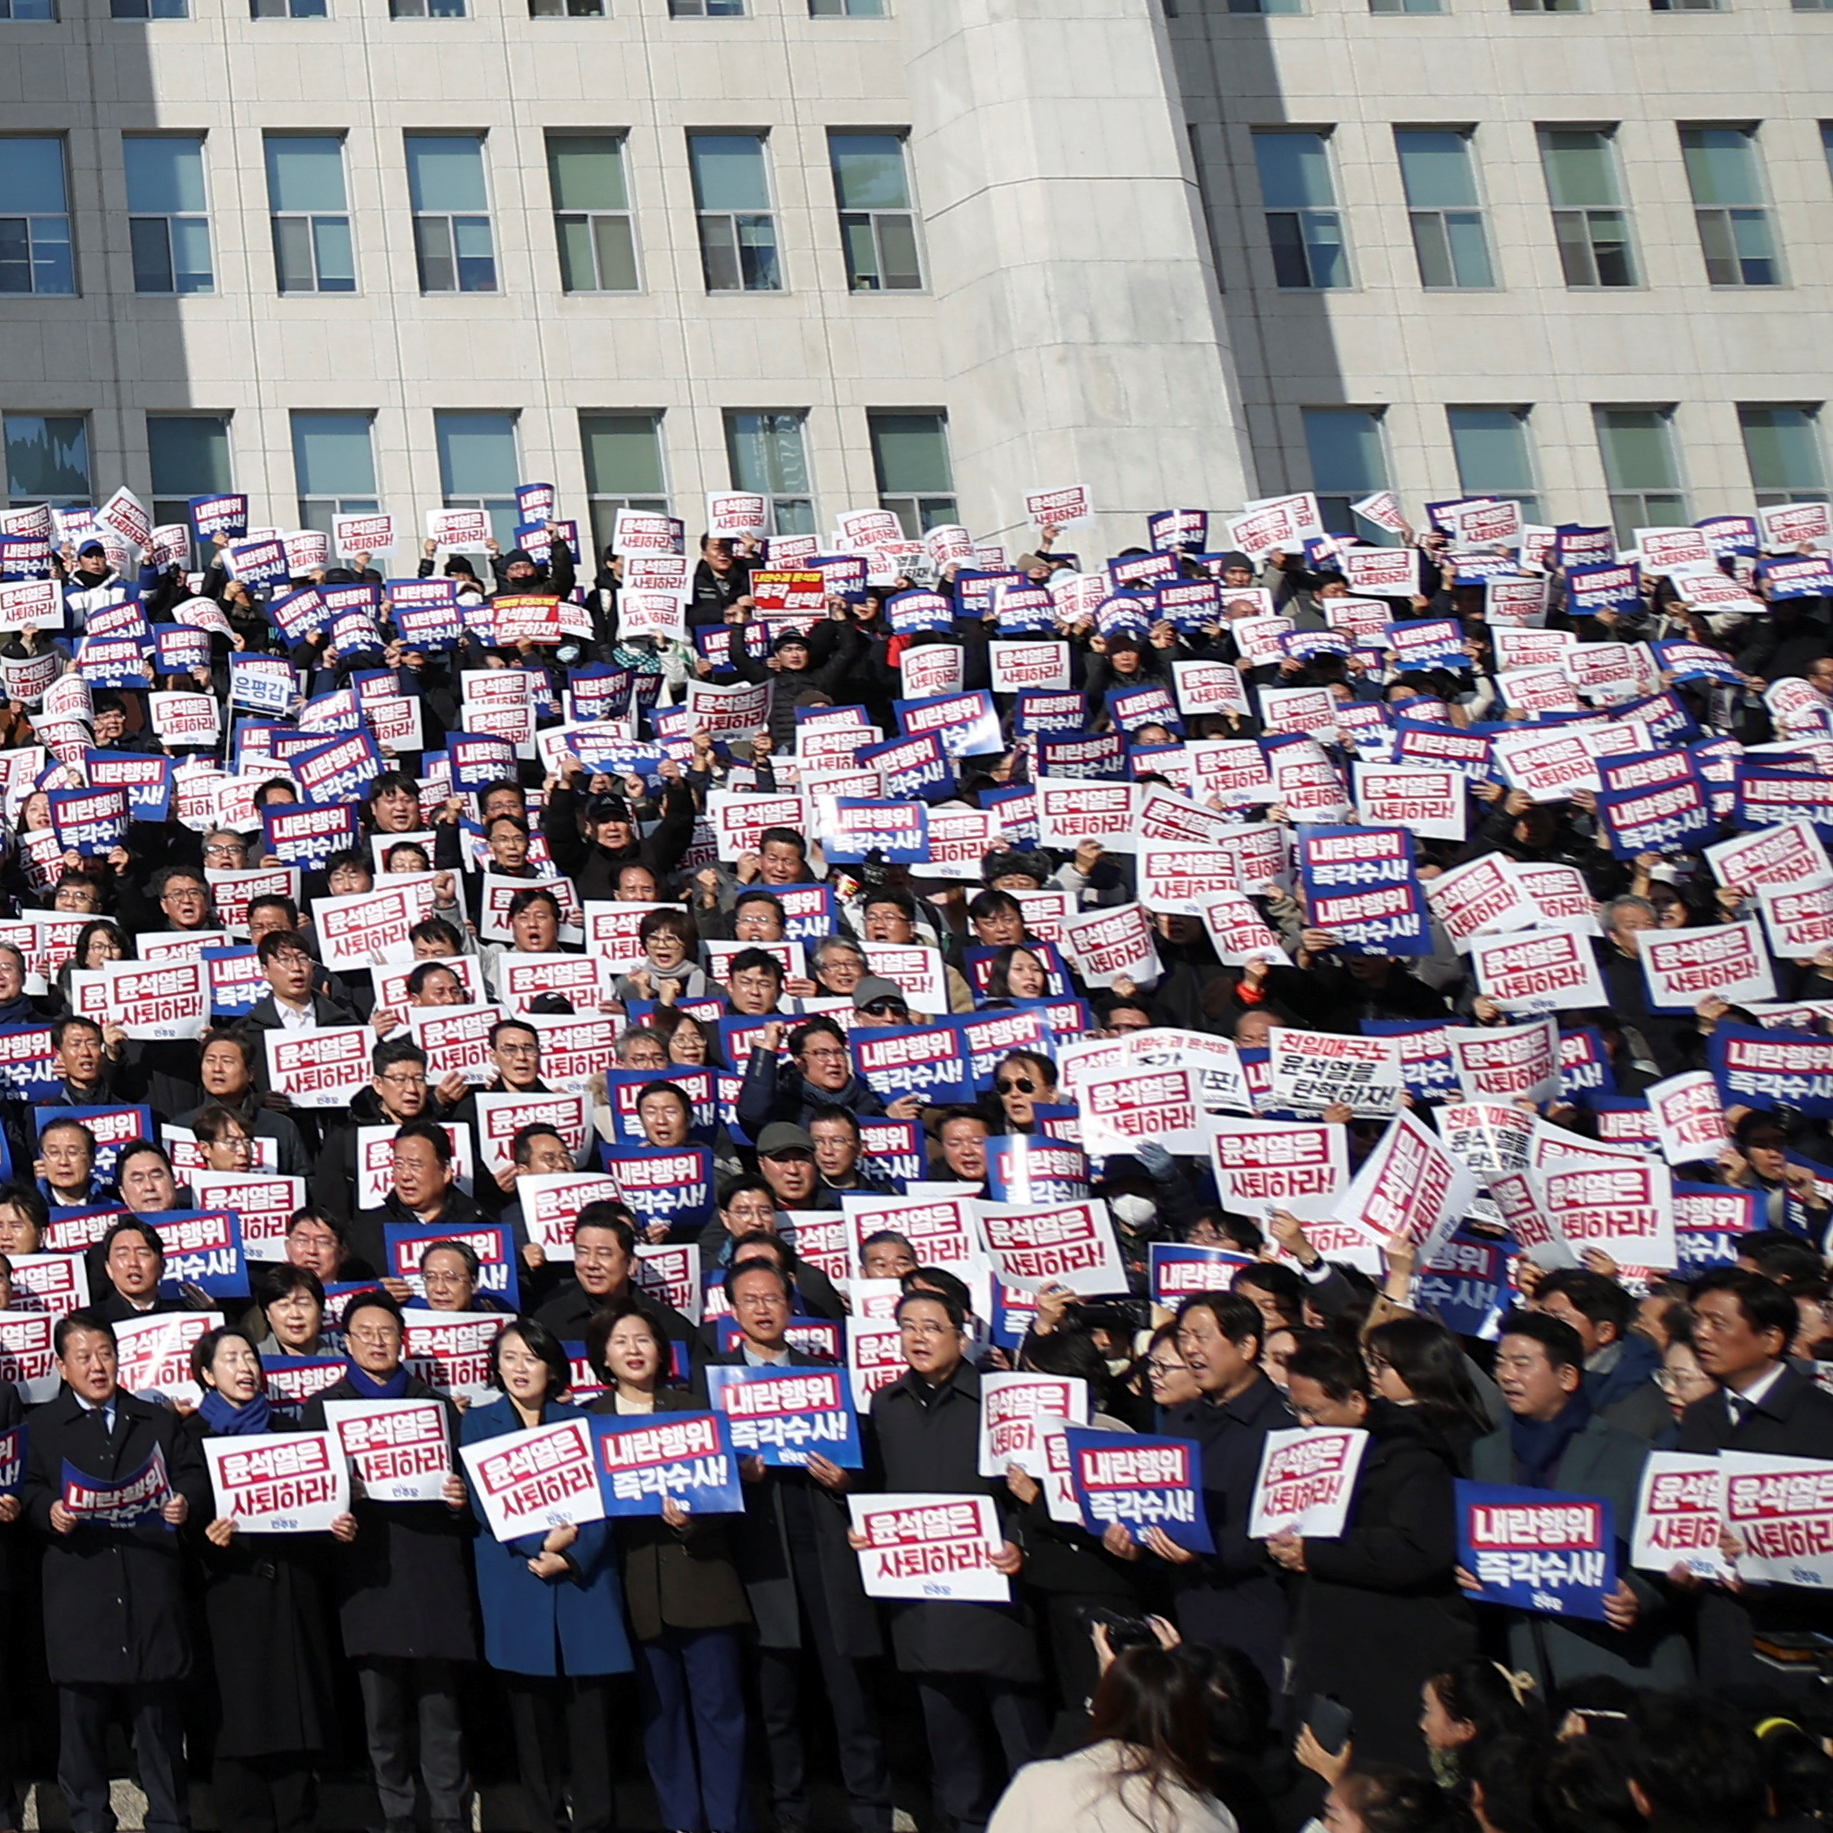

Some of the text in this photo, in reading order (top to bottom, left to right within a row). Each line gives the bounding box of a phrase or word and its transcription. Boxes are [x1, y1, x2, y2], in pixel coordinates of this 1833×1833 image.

[755, 584, 790, 599] 즉각
[234, 676, 284, 701] 은평갑
[297, 741, 371, 782] 내란행위
[1042, 785, 1130, 816] 윤석열은
[1362, 776, 1455, 805] 윤석열은
[1606, 784, 1702, 824] 내란행위
[55, 796, 124, 825] 내란행위
[272, 807, 352, 841] 내란행위
[1049, 811, 1133, 836] 사퇴하라!
[1371, 796, 1456, 822] 사퇴하라!
[1149, 850, 1232, 877] 윤석열은
[1310, 832, 1401, 861] 내란행위
[325, 895, 408, 937] 윤석열은
[1315, 888, 1411, 923] 내란행위
[1482, 937, 1578, 976] 윤석열은
[1649, 929, 1749, 971] 윤석열은
[114, 968, 198, 999] 윤석열은
[509, 961, 599, 994] 윤석열은
[1493, 966, 1587, 1000] 사퇴하라!
[1662, 959, 1760, 993] 사퇴하라!
[122, 995, 202, 1026] 사퇴하라!
[277, 1032, 366, 1071] 윤석열은
[859, 1035, 958, 1069] 내란행위
[1279, 1034, 1391, 1061] 친일매국노
[283, 1062, 371, 1095] 사퇴하라!
[867, 1061, 963, 1096] 즉각수사!
[1281, 1055, 1376, 1082] 윤석열을
[1293, 1079, 1396, 1106] 탄핵하자!
[1217, 1130, 1329, 1168] 윤석열은
[611, 1155, 699, 1188] 내란행위
[1228, 1165, 1336, 1199] 사퇴하라!
[1548, 1170, 1650, 1209] 윤석열은
[985, 1207, 1091, 1248] 윤석열은
[1001, 1244, 1104, 1277] 사퇴하라!
[727, 1374, 836, 1418] 내란행위
[343, 1409, 440, 1452] 윤석열은
[606, 1419, 713, 1468] 내란행위
[730, 1412, 848, 1448] 즉각수사!
[223, 1444, 327, 1485] 윤석열은
[484, 1431, 583, 1489] 윤석열은
[1081, 1449, 1185, 1484] 내란행위
[1267, 1438, 1348, 1484] 윤석열은
[231, 1476, 336, 1519] 사퇴하라!
[612, 1459, 727, 1501] 즉각수사!
[1089, 1490, 1194, 1525] 즉각수사!
[1262, 1477, 1341, 1519] 사퇴하라!
[869, 1505, 977, 1545] 윤석열은
[1473, 1509, 1595, 1547] 내란행위
[1477, 1552, 1606, 1589] 즉각수사!
